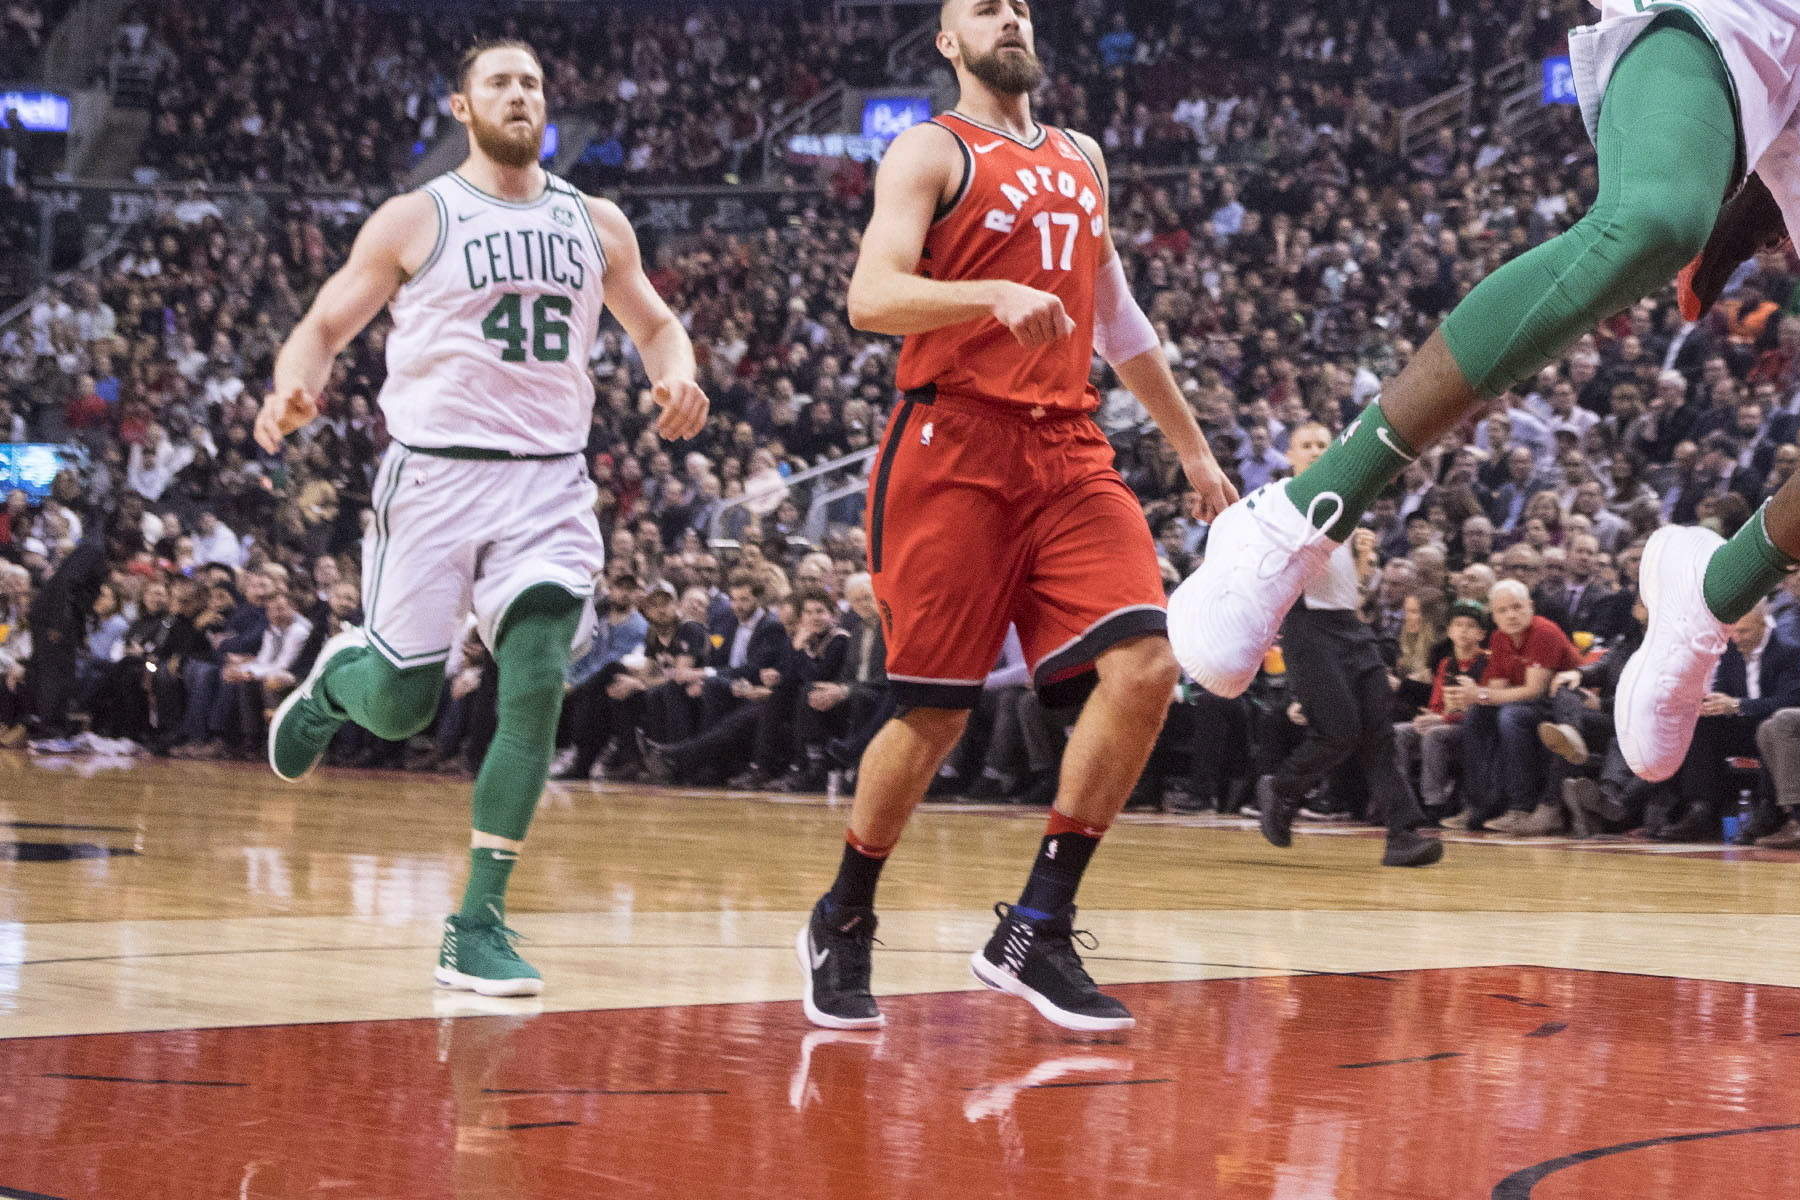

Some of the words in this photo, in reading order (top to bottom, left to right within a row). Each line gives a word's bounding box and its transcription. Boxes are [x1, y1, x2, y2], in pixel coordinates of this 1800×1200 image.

[984, 165, 1103, 238] RAPTORS
[464, 230, 584, 290] CELTICS
[1032, 211, 1079, 271] 17
[481, 293, 572, 362] 46
